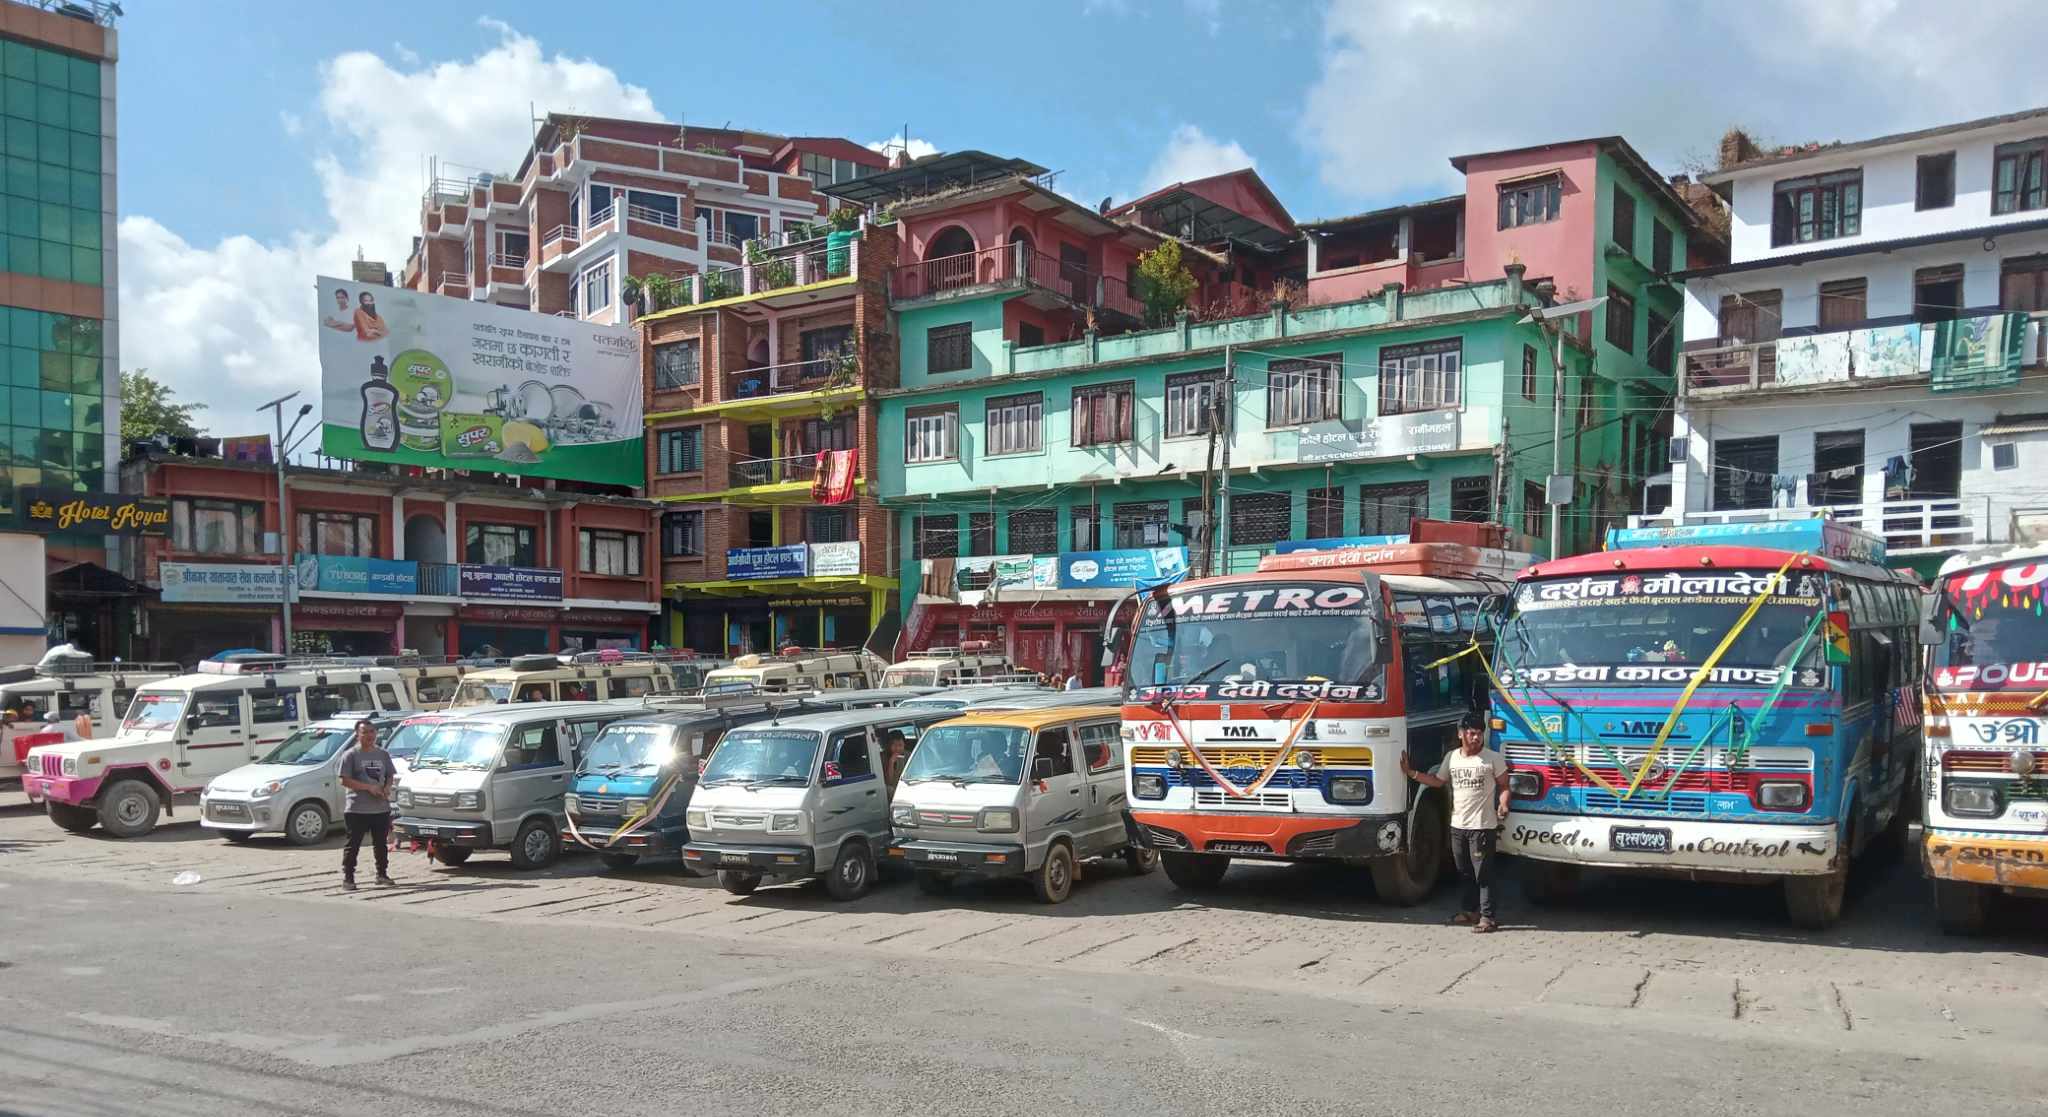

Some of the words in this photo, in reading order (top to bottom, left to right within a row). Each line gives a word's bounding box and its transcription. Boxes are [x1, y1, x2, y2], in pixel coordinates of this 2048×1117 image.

[519, 343, 560, 362] कागती
[58, 500, 111, 529] Hotel
[111, 503, 168, 530] Royal
[1363, 548, 1394, 563] दर्शन
[1540, 577, 1619, 600] दर्शन
[1643, 571, 1791, 596] मौलादेवी
[1158, 587, 1364, 616] METRO
[1217, 680, 1272, 699] देवी
[1276, 679, 1362, 699] दर्शन
[1223, 726, 1258, 738] TATA
